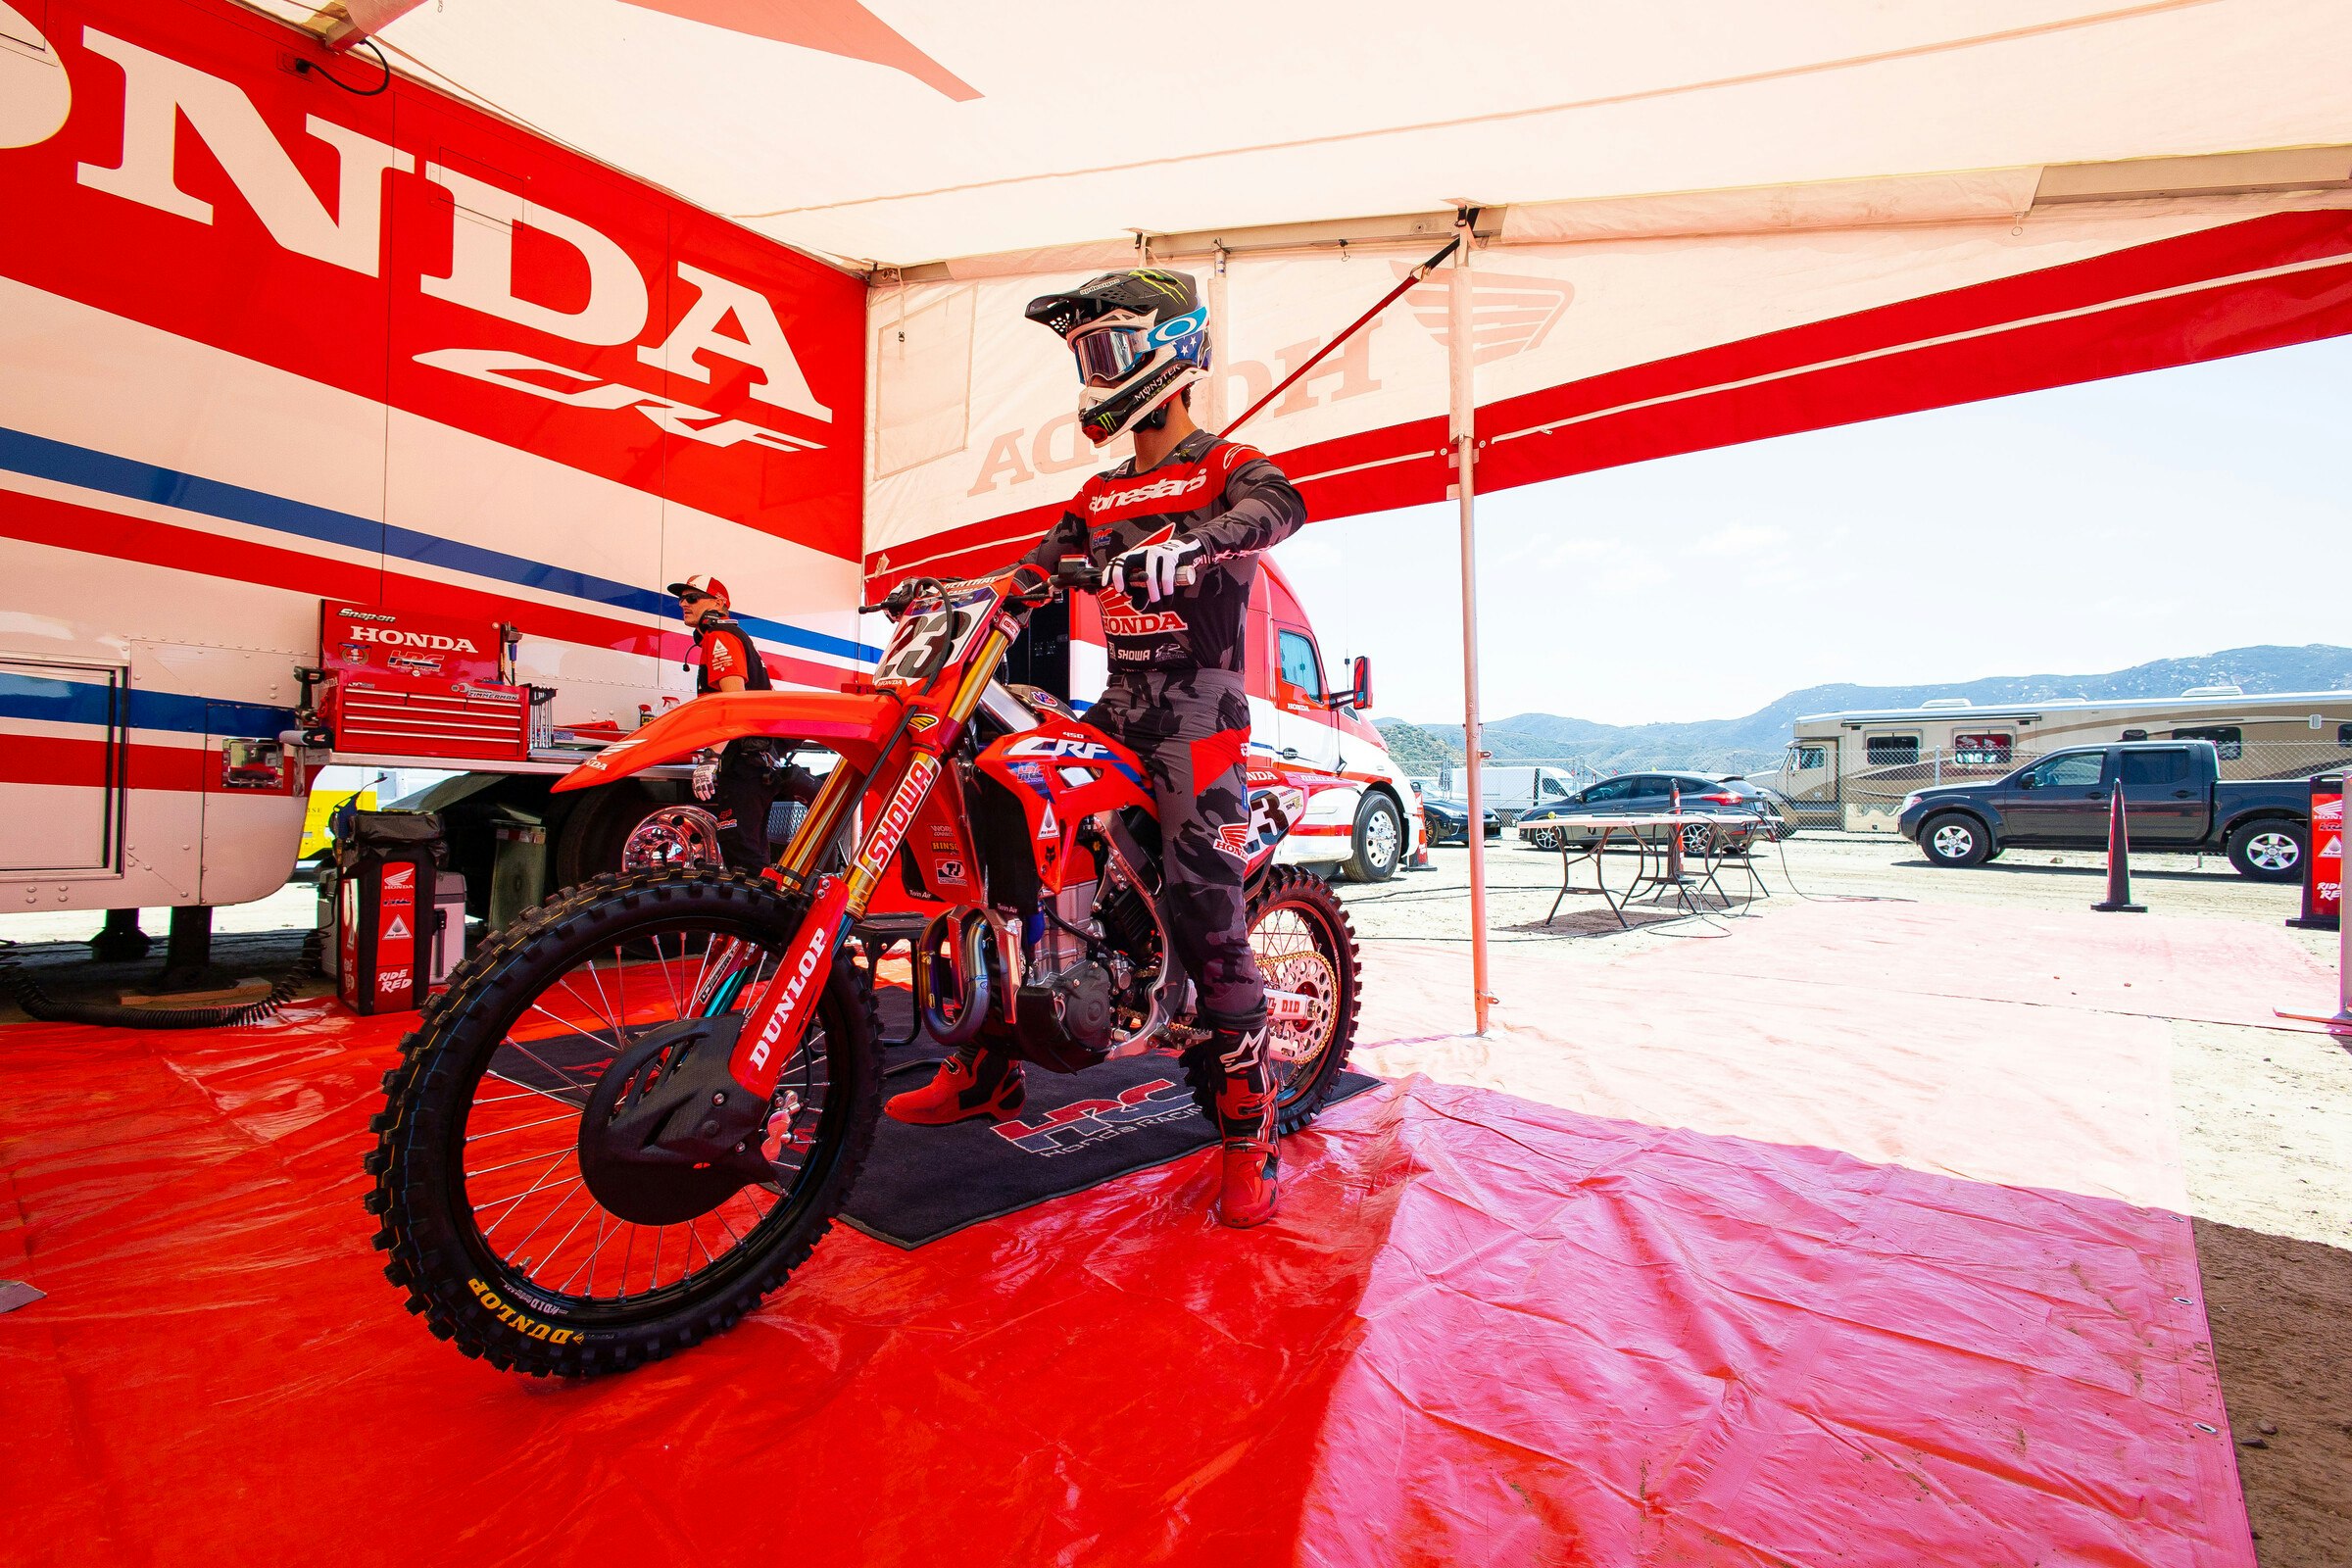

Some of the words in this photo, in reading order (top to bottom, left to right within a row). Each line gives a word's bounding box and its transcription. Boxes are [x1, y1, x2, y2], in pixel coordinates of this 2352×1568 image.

[0, 0, 833, 423] NDA
[1134, 364, 1181, 402] MONSTER
[412, 348, 828, 452] CRF
[338, 608, 396, 623] Snap-on
[350, 625, 478, 654] HONDA
[876, 611, 972, 679] 23
[387, 650, 445, 668] HRC
[1117, 649, 1151, 662] SHOWA
[467, 691, 518, 702] ZIMMERMAN
[1004, 736, 1111, 760] CRF
[1247, 769, 1278, 781] NDA
[865, 760, 934, 873] SHOWA
[932, 842, 958, 851] HINS
[1214, 840, 1249, 859] HOND
[2320, 890, 2342, 902] RE
[378, 968, 409, 982] RIDE
[380, 978, 413, 994] RED
[750, 927, 826, 1072] DUNLOP
[1281, 999, 1300, 1013] DID
[990, 1077, 1196, 1153] HRC
[1040, 1125, 1138, 1157] Honda
[1136, 1104, 1203, 1128] RACIN
[467, 1278, 574, 1345] DUNLOP
